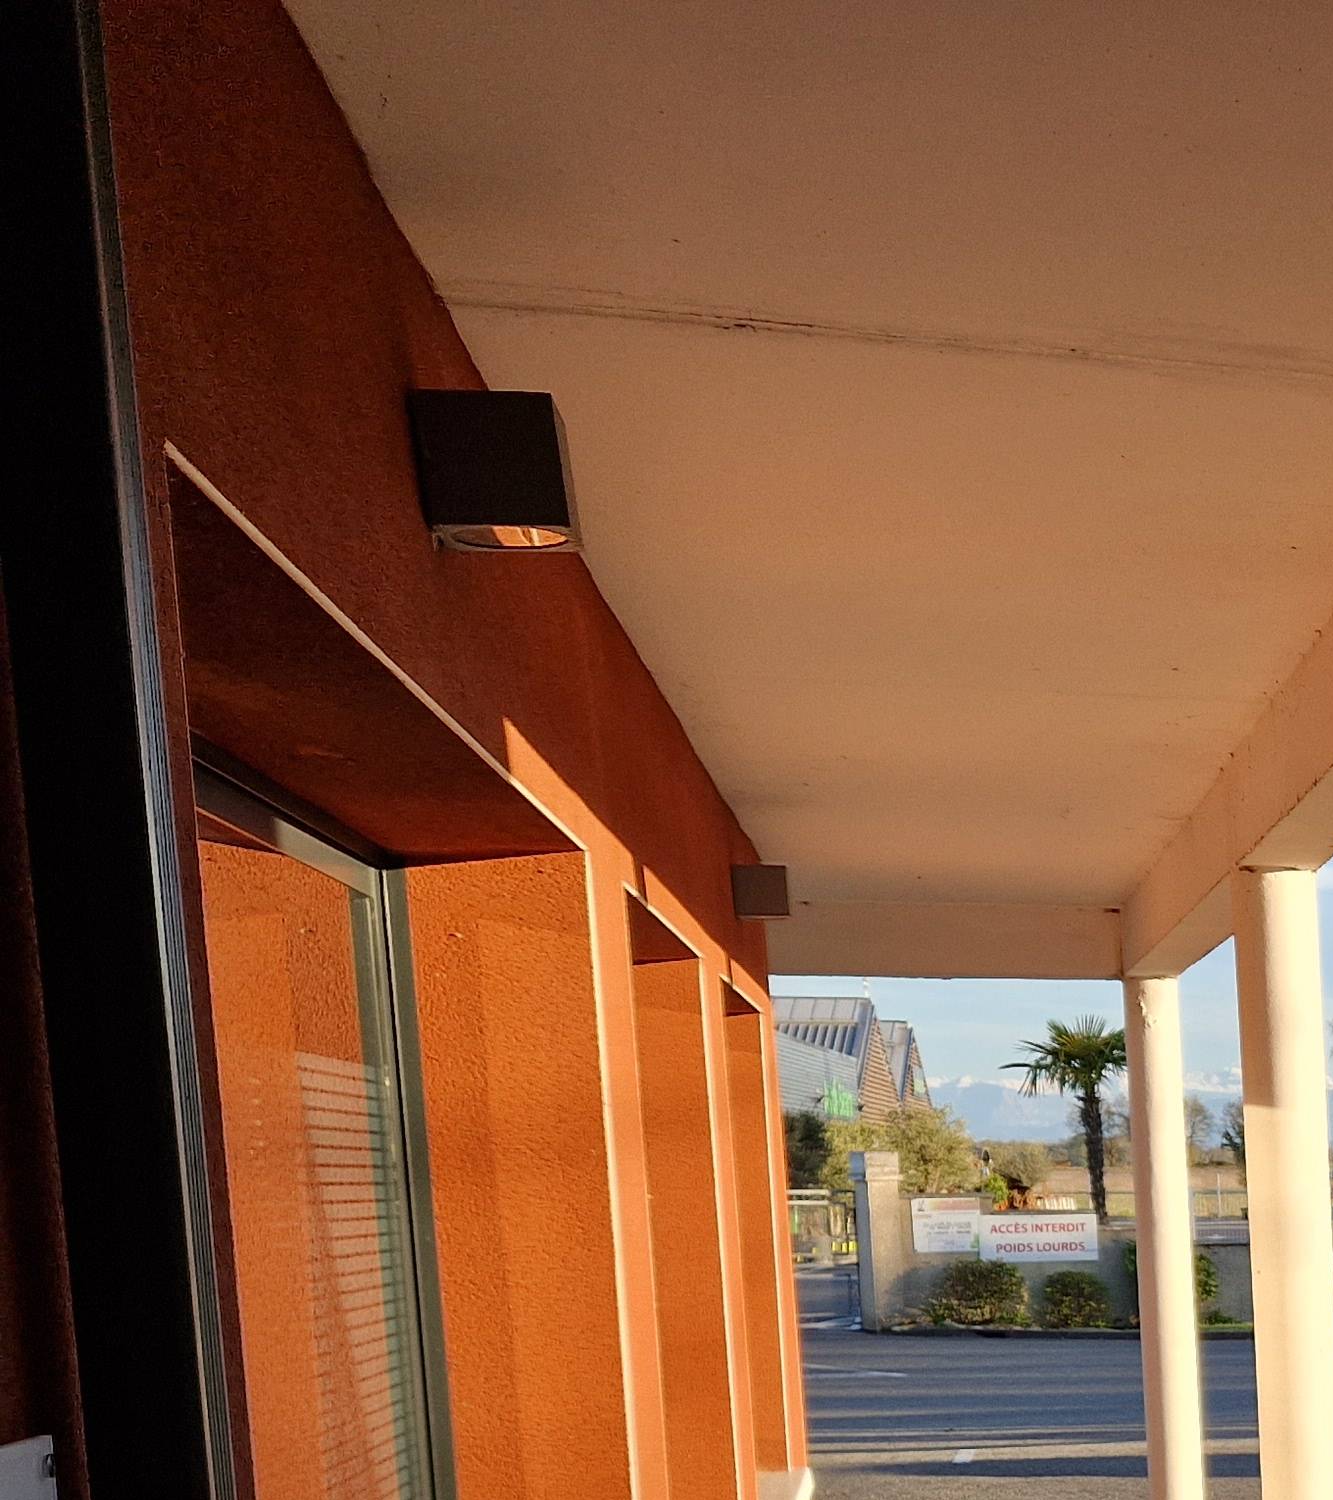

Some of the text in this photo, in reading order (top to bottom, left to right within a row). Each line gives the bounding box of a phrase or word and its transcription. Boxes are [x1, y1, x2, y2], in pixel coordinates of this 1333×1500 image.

[990, 1221, 1087, 1234] ACCÈS INTERDIT
[996, 1241, 1086, 1253] POIDS LOURDS
